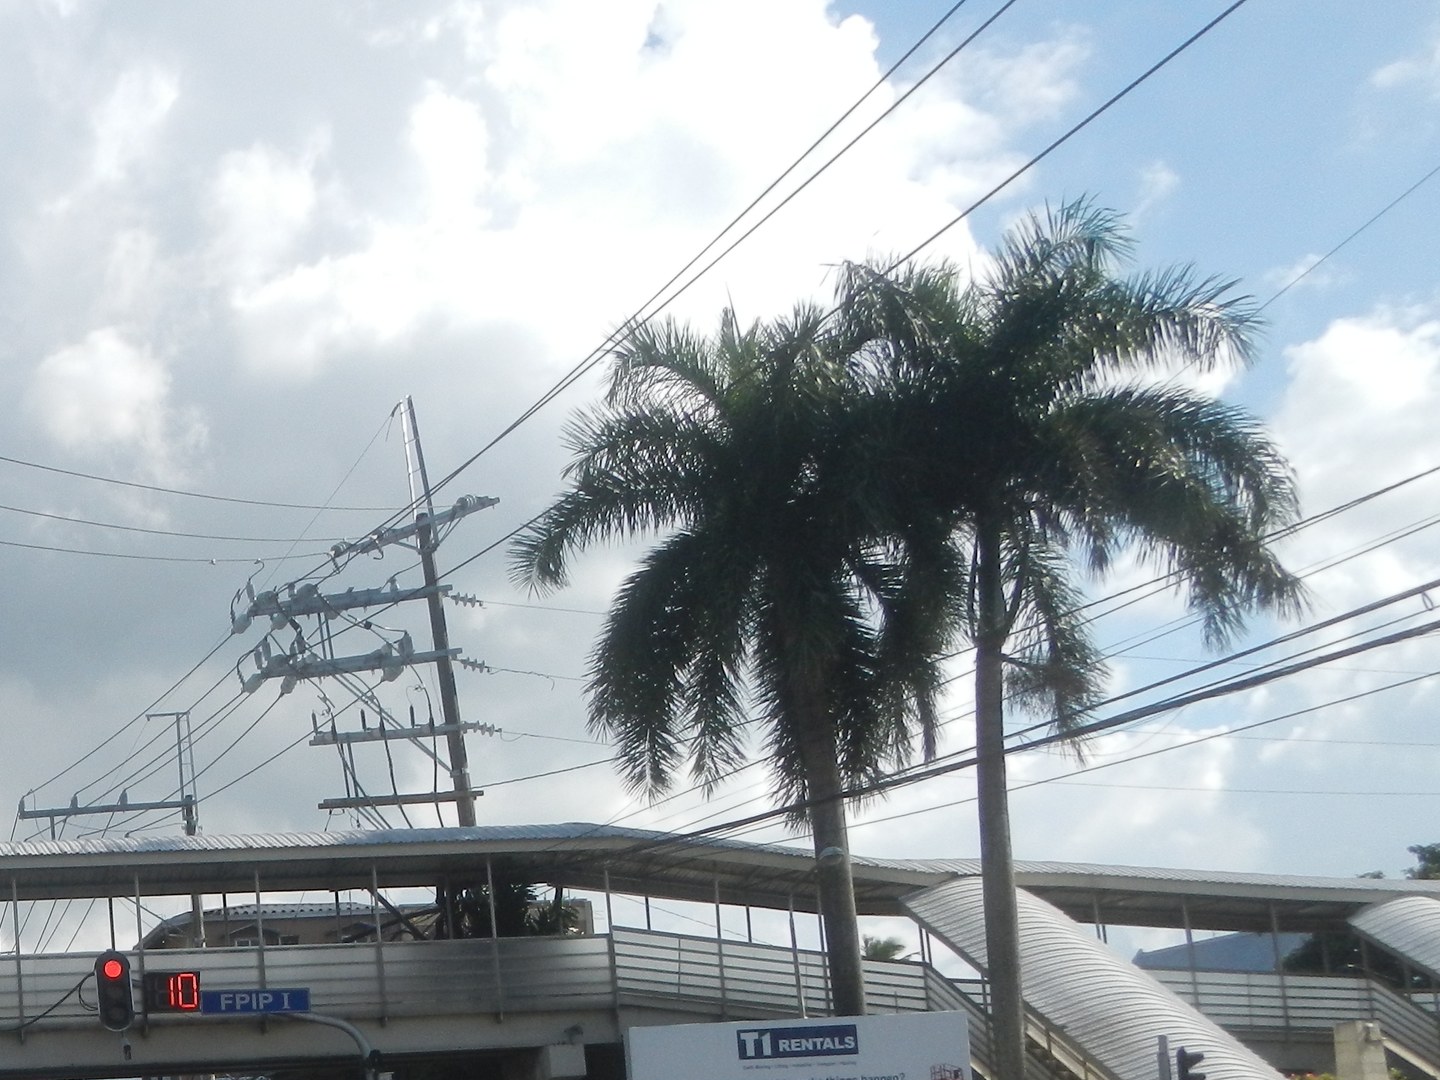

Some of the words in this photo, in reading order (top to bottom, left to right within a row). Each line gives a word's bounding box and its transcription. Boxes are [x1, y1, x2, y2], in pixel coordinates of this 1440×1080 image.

[168, 973, 198, 1008] 10
[220, 993, 273, 1011] FPIP
[280, 992, 291, 1009] I
[740, 1031, 772, 1057] T1
[778, 1036, 856, 1052] RENTALS
